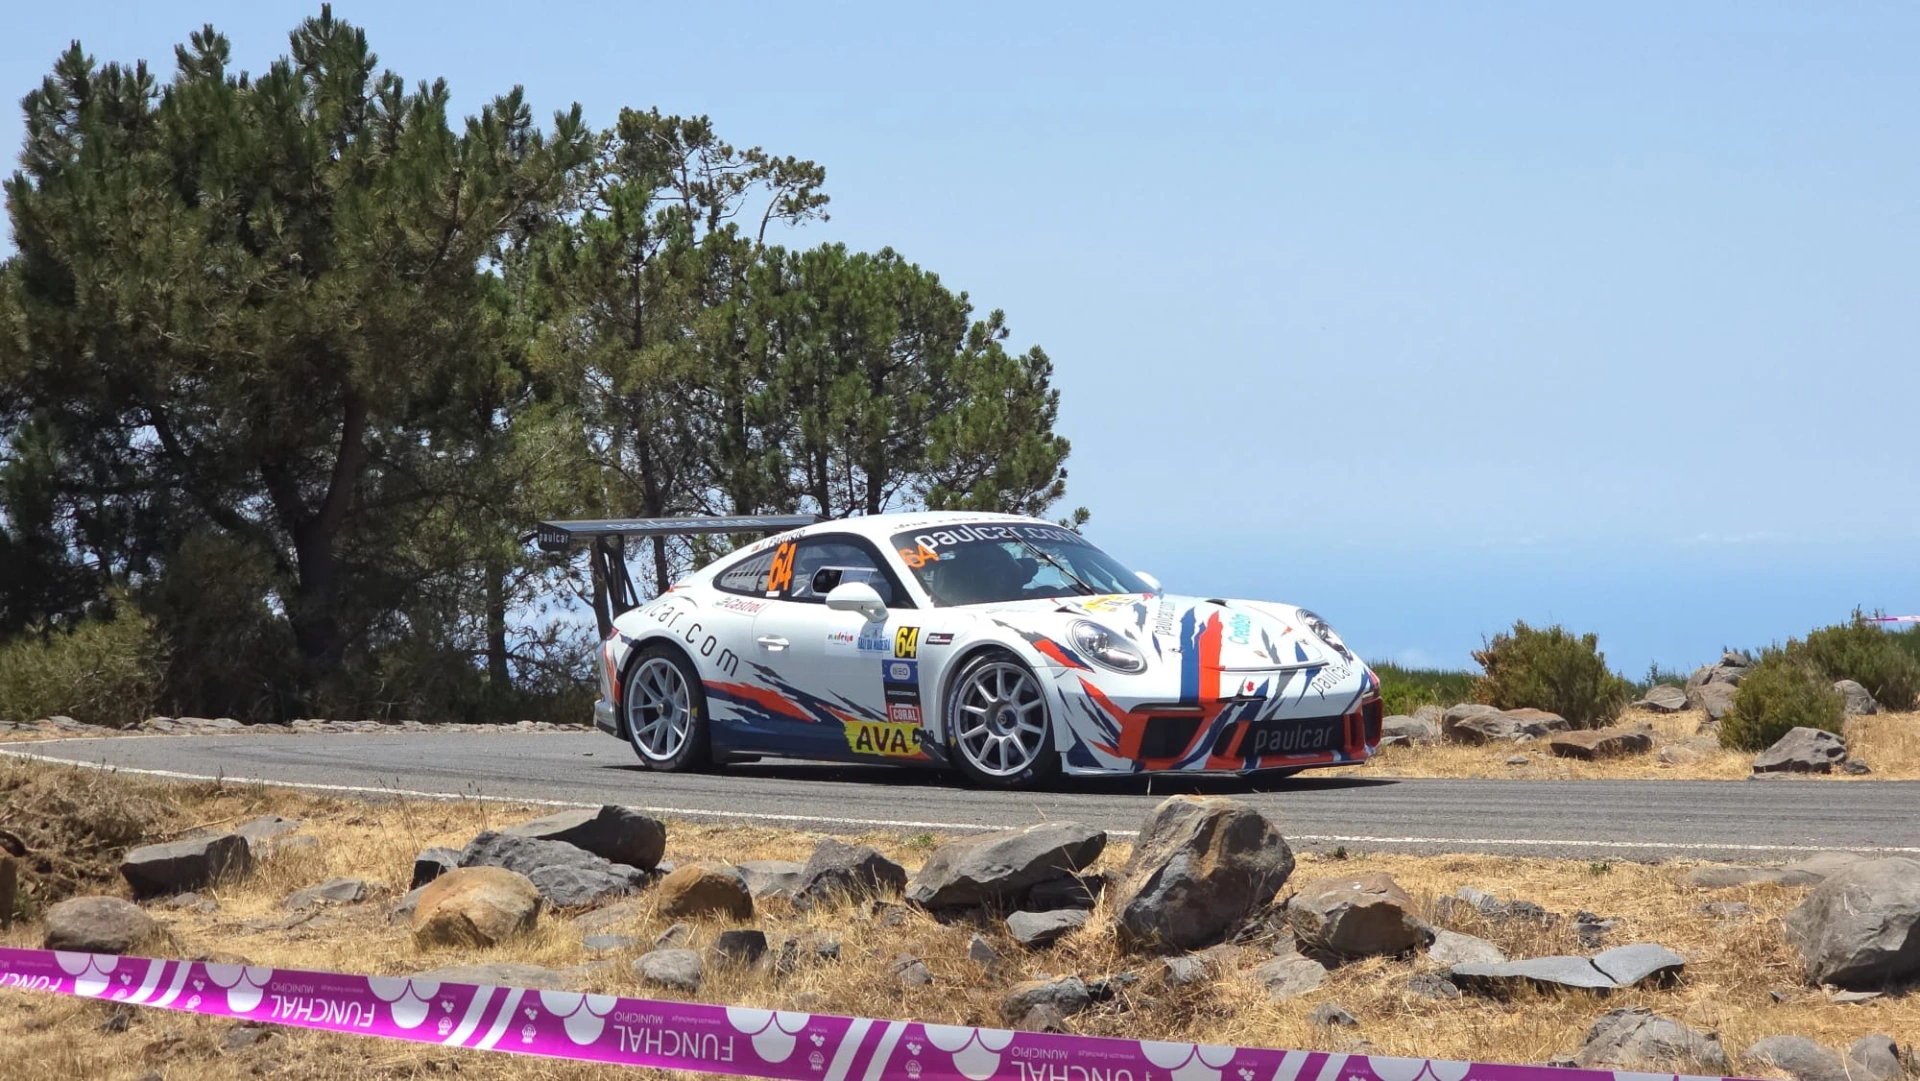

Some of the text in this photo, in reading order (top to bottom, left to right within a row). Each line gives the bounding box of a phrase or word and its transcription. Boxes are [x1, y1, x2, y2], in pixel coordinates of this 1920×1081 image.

[538, 531, 569, 546] paulcar
[915, 525, 1086, 555] paulcar.com
[768, 542, 797, 591] 64
[900, 544, 939, 568] 64
[723, 599, 763, 613] Castrol
[895, 627, 918, 657] 64
[893, 708, 918, 721] CORAL
[856, 725, 909, 753] AVA
[1254, 724, 1335, 754] paulcar
[271, 995, 375, 1028] FUNCHAL
[614, 1010, 663, 1025] MUNICÍPIO
[614, 1025, 733, 1061] FUNCHAL
[1011, 1046, 1068, 1060] MUNICÍPIO
